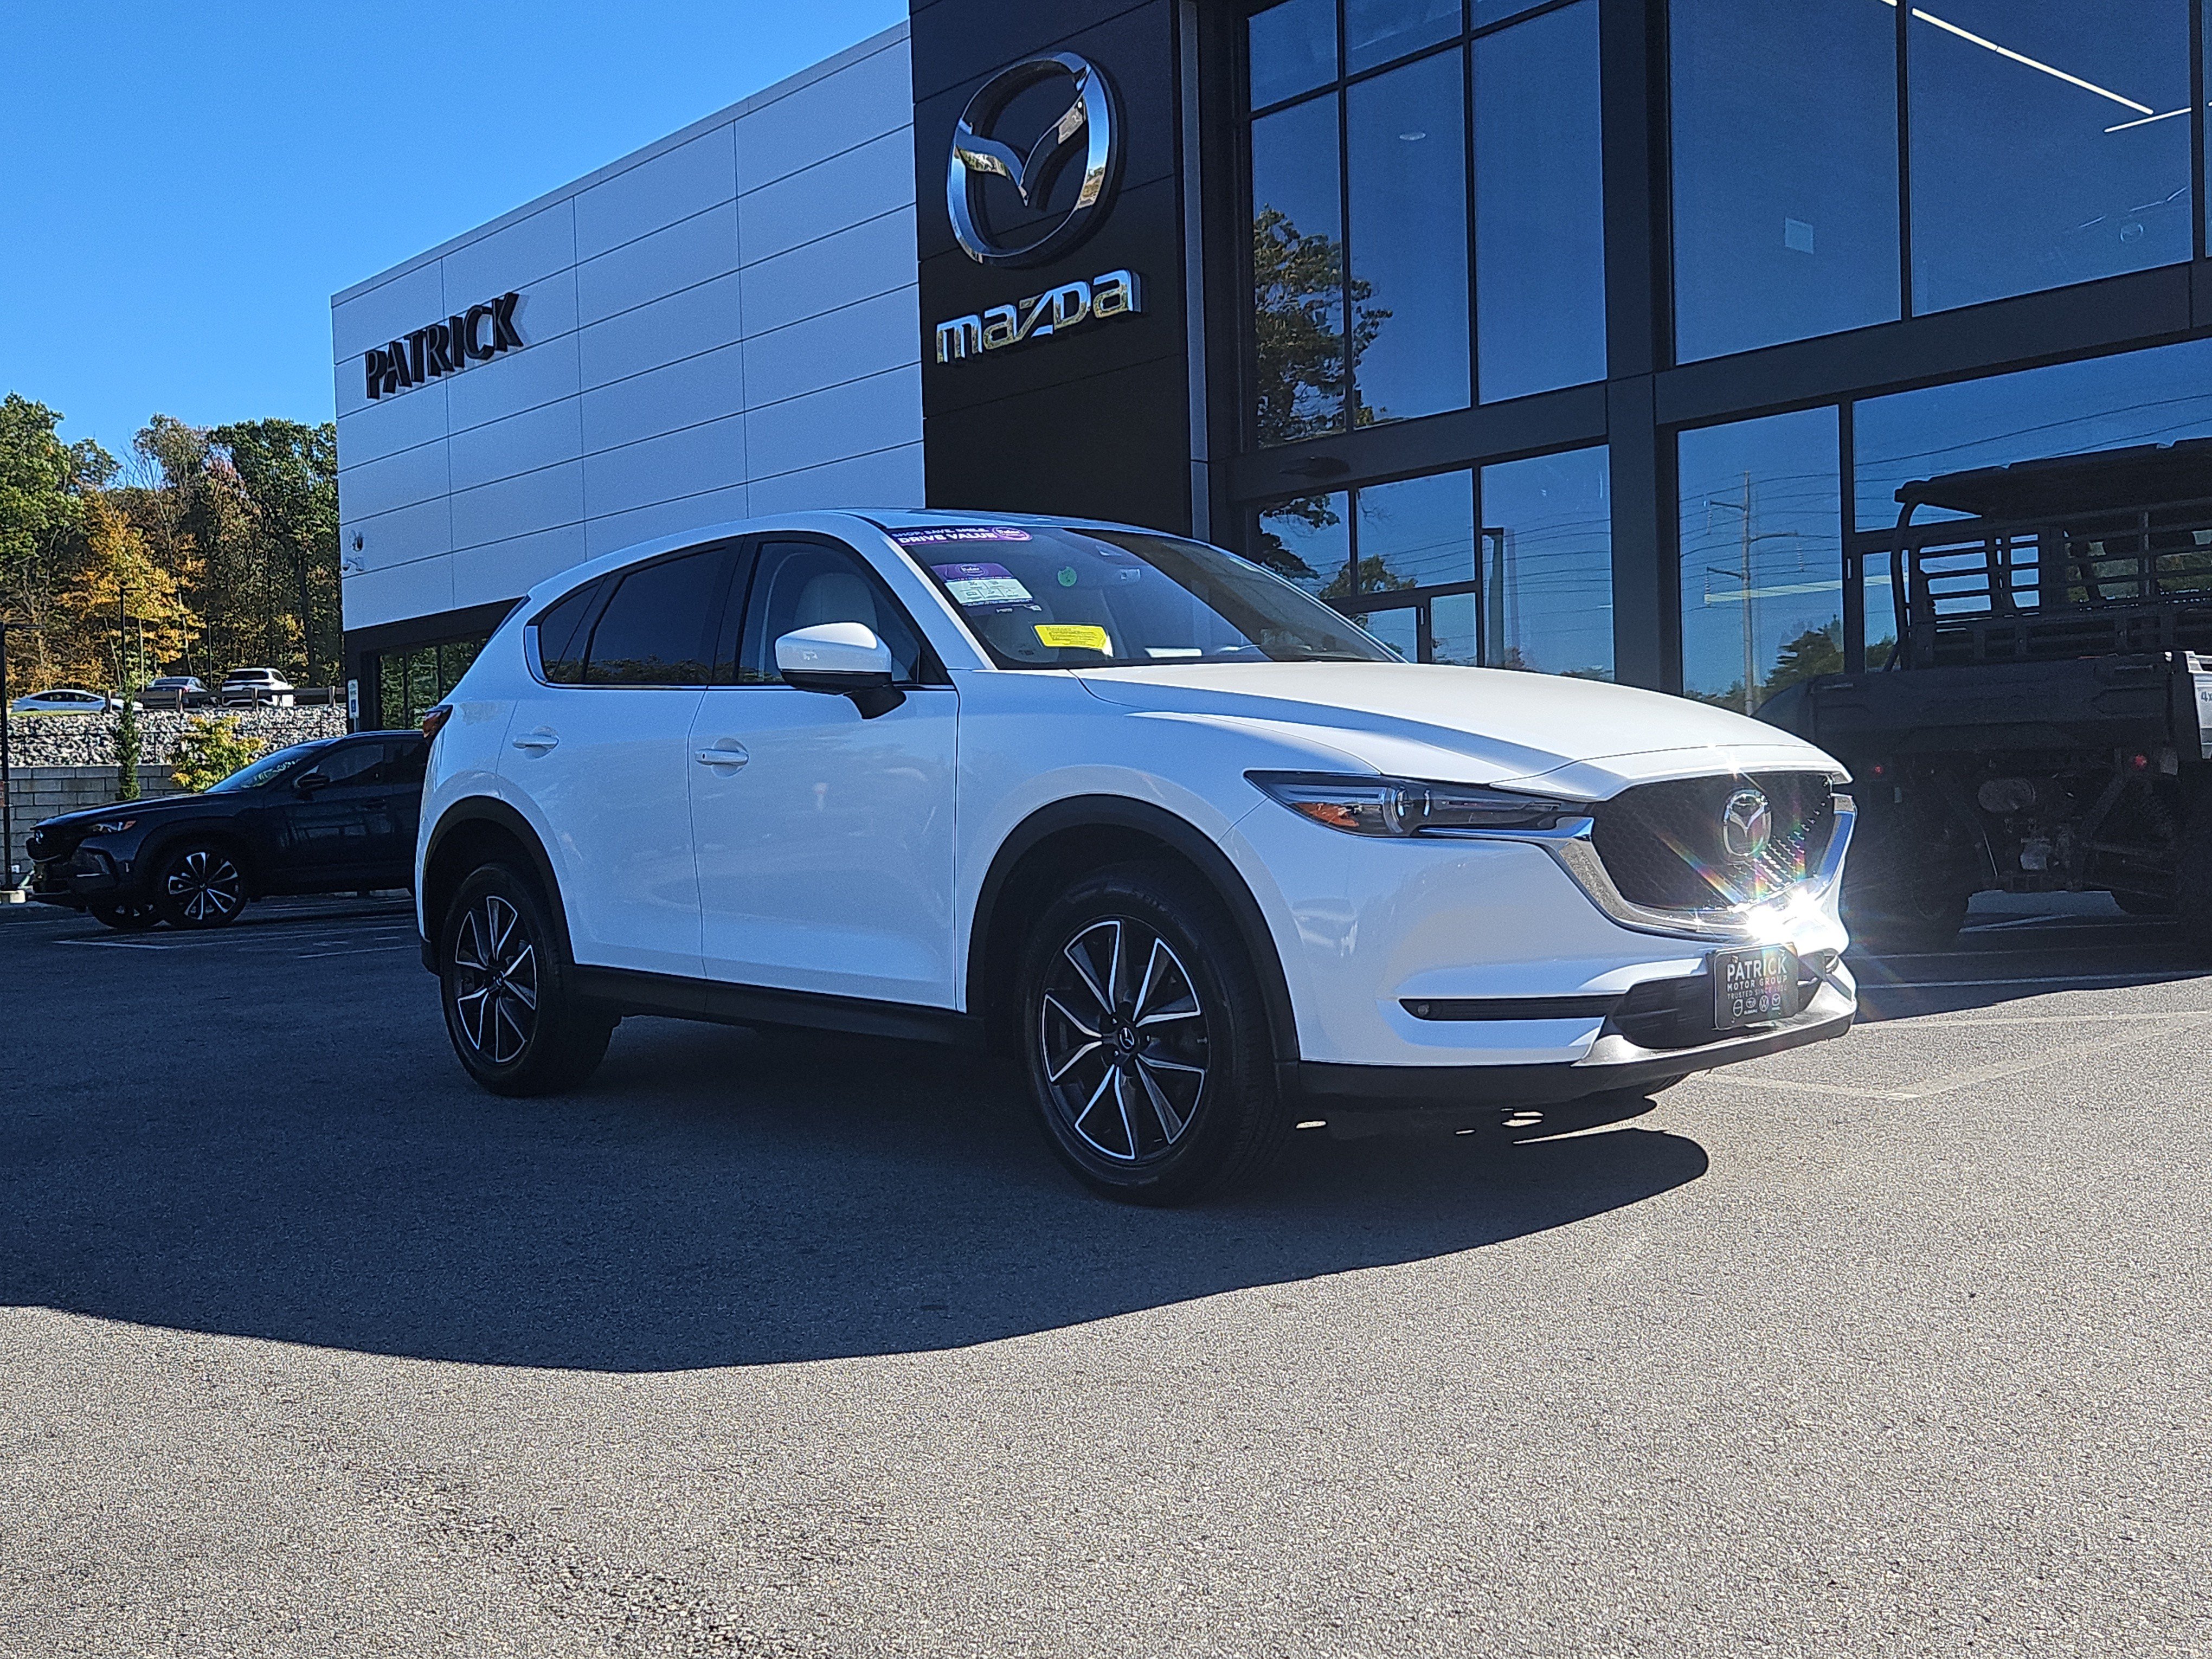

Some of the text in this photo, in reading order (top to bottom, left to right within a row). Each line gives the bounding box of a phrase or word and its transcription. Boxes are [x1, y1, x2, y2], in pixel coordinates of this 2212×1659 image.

[365, 292, 524, 400] PATRICK
[897, 535, 947, 543] DRIVE
[1727, 956, 1787, 982] PATRICK
[1727, 975, 1787, 992] MOTOR GROUP
[1727, 989, 1753, 1000] TRUSTED
[1755, 986, 1772, 996] SINCE
